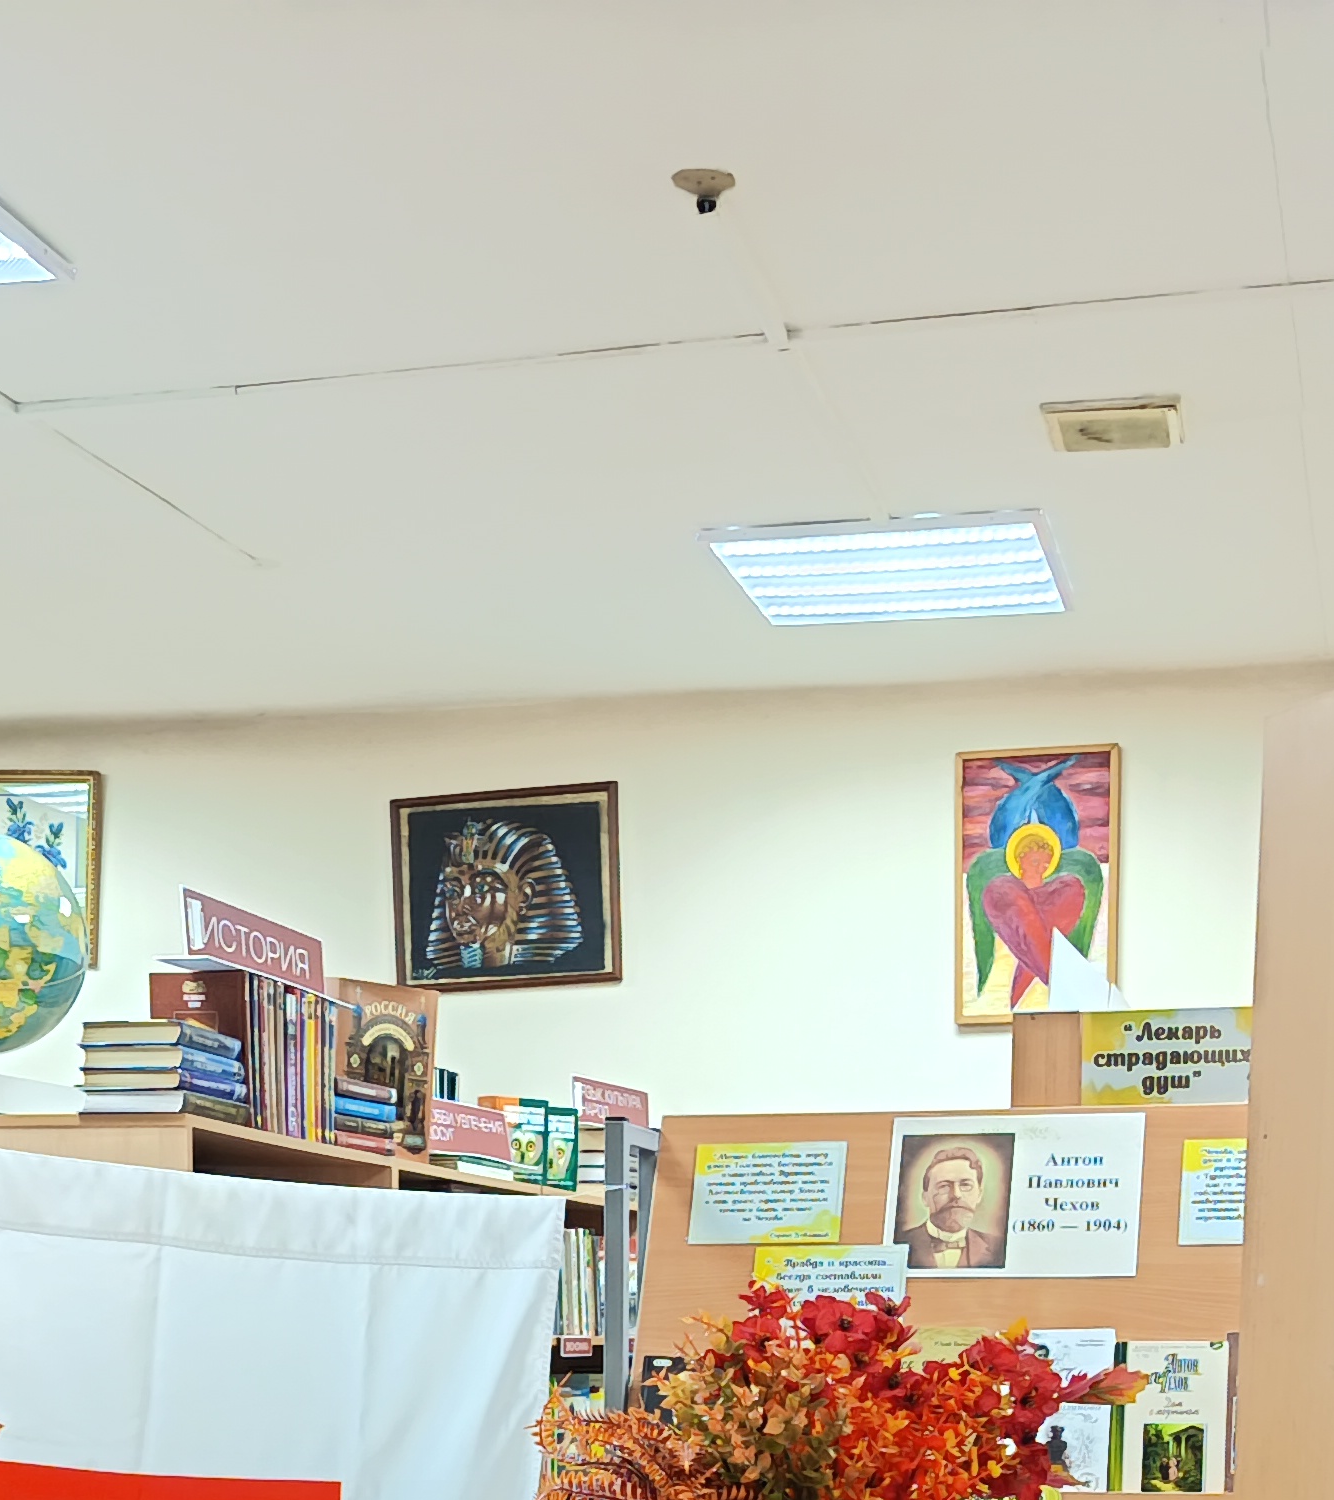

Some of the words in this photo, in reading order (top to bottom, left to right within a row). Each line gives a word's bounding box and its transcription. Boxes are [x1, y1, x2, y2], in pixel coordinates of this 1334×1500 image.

[202, 916, 310, 980] ИСТОРИЯ
[365, 1000, 416, 1025] РОССИЯ
[1093, 1048, 1251, 1072] страдающих
[1045, 1153, 1104, 1168] Антон
[1027, 1174, 1120, 1190] Павлович
[1043, 1197, 1101, 1212] Чехов
[1012, 1218, 1056, 1234] (1860
[1084, 1218, 1128, 1234] 1904)
